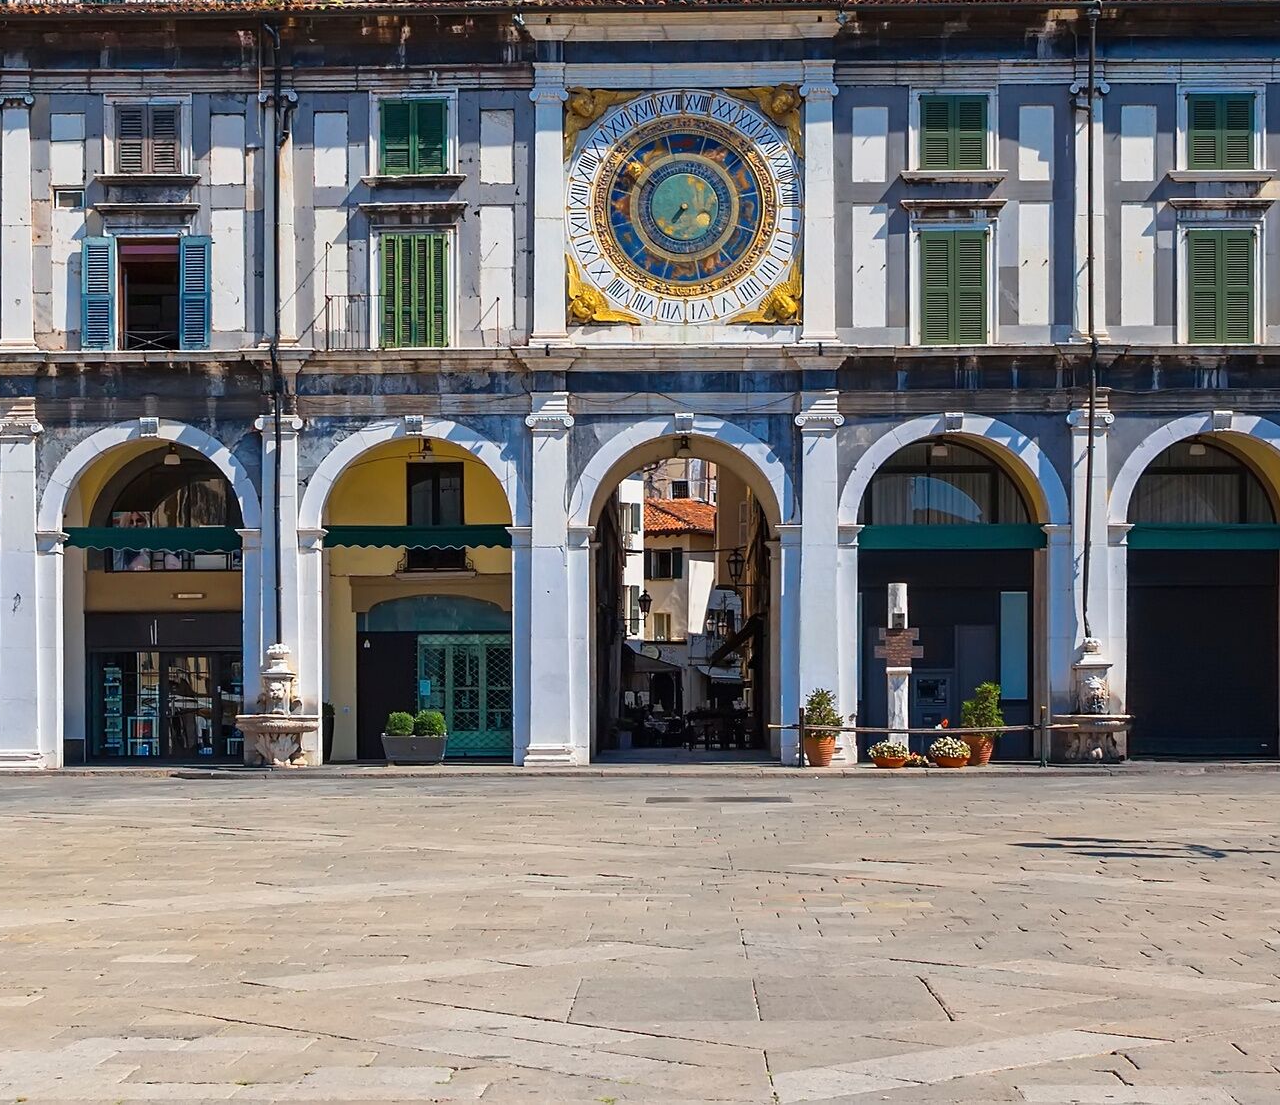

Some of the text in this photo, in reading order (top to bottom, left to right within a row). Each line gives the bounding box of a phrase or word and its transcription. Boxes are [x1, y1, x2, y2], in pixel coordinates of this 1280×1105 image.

[712, 99, 737, 122] XX
[605, 111, 632, 138] XVI
[735, 110, 762, 135] XXI
[587, 130, 610, 158] XV
[569, 183, 589, 206] XIII
[569, 212, 589, 234] XII
[576, 240, 598, 260] XI
[774, 238, 792, 254] II
[591, 264, 611, 281] X
[759, 260, 780, 281] III
[738, 278, 761, 301] IIII
[631, 294, 654, 315] VIII
[661, 302, 682, 320] VII
[691, 303, 710, 319] VI
[722, 297, 735, 313] V
